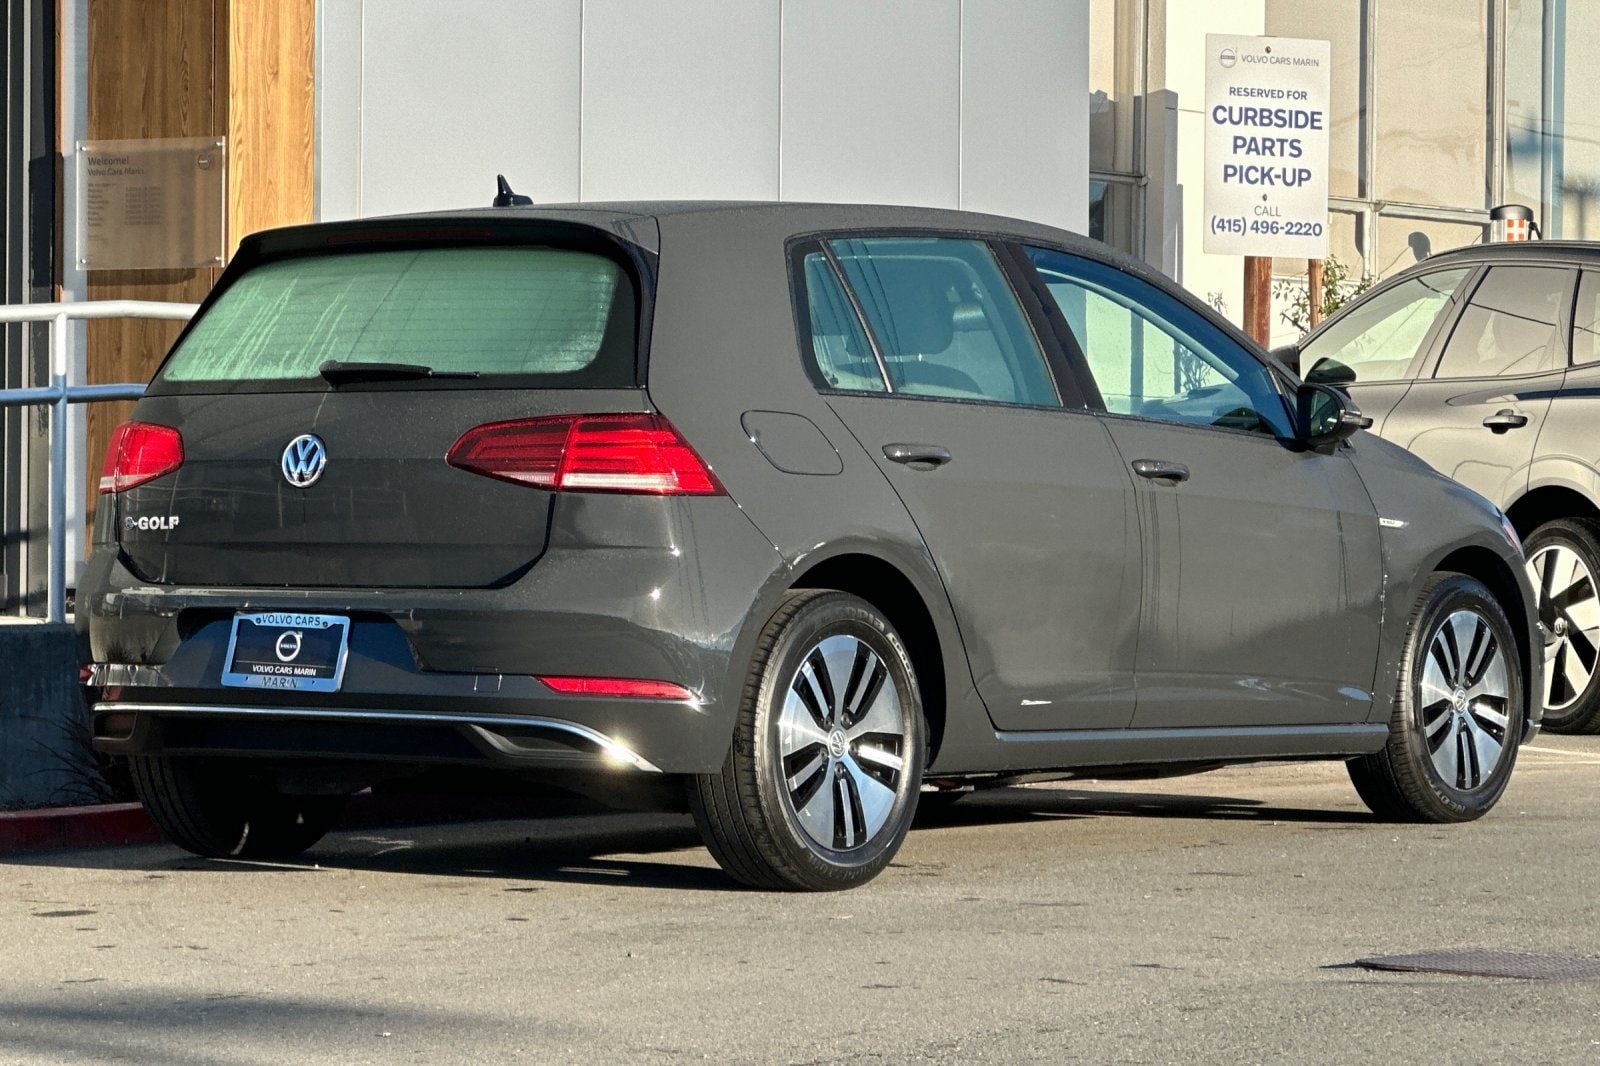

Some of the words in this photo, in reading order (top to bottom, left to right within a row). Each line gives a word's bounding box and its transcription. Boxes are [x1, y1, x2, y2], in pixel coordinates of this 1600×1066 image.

[1241, 54, 1268, 64] VOLVO
[1269, 56, 1291, 65] CARS
[1293, 58, 1320, 67] MARIN
[1229, 86, 1285, 99] RESERVED
[1286, 90, 1308, 100] FOR
[1212, 105, 1323, 130] CURBSIDE
[1232, 135, 1303, 158] PARTS
[1223, 164, 1312, 187] PICK-UP
[1254, 205, 1282, 217] CALL
[1211, 215, 1247, 236] (415)
[1250, 220, 1323, 237] 496-2220
[261, 614, 293, 625] VOLVO
[295, 616, 321, 626] CARS
[252, 664, 274, 674] VOLVO
[275, 665, 293, 674] CARS
[293, 667, 317, 676] MARIN
[262, 676, 298, 689] MARIN
